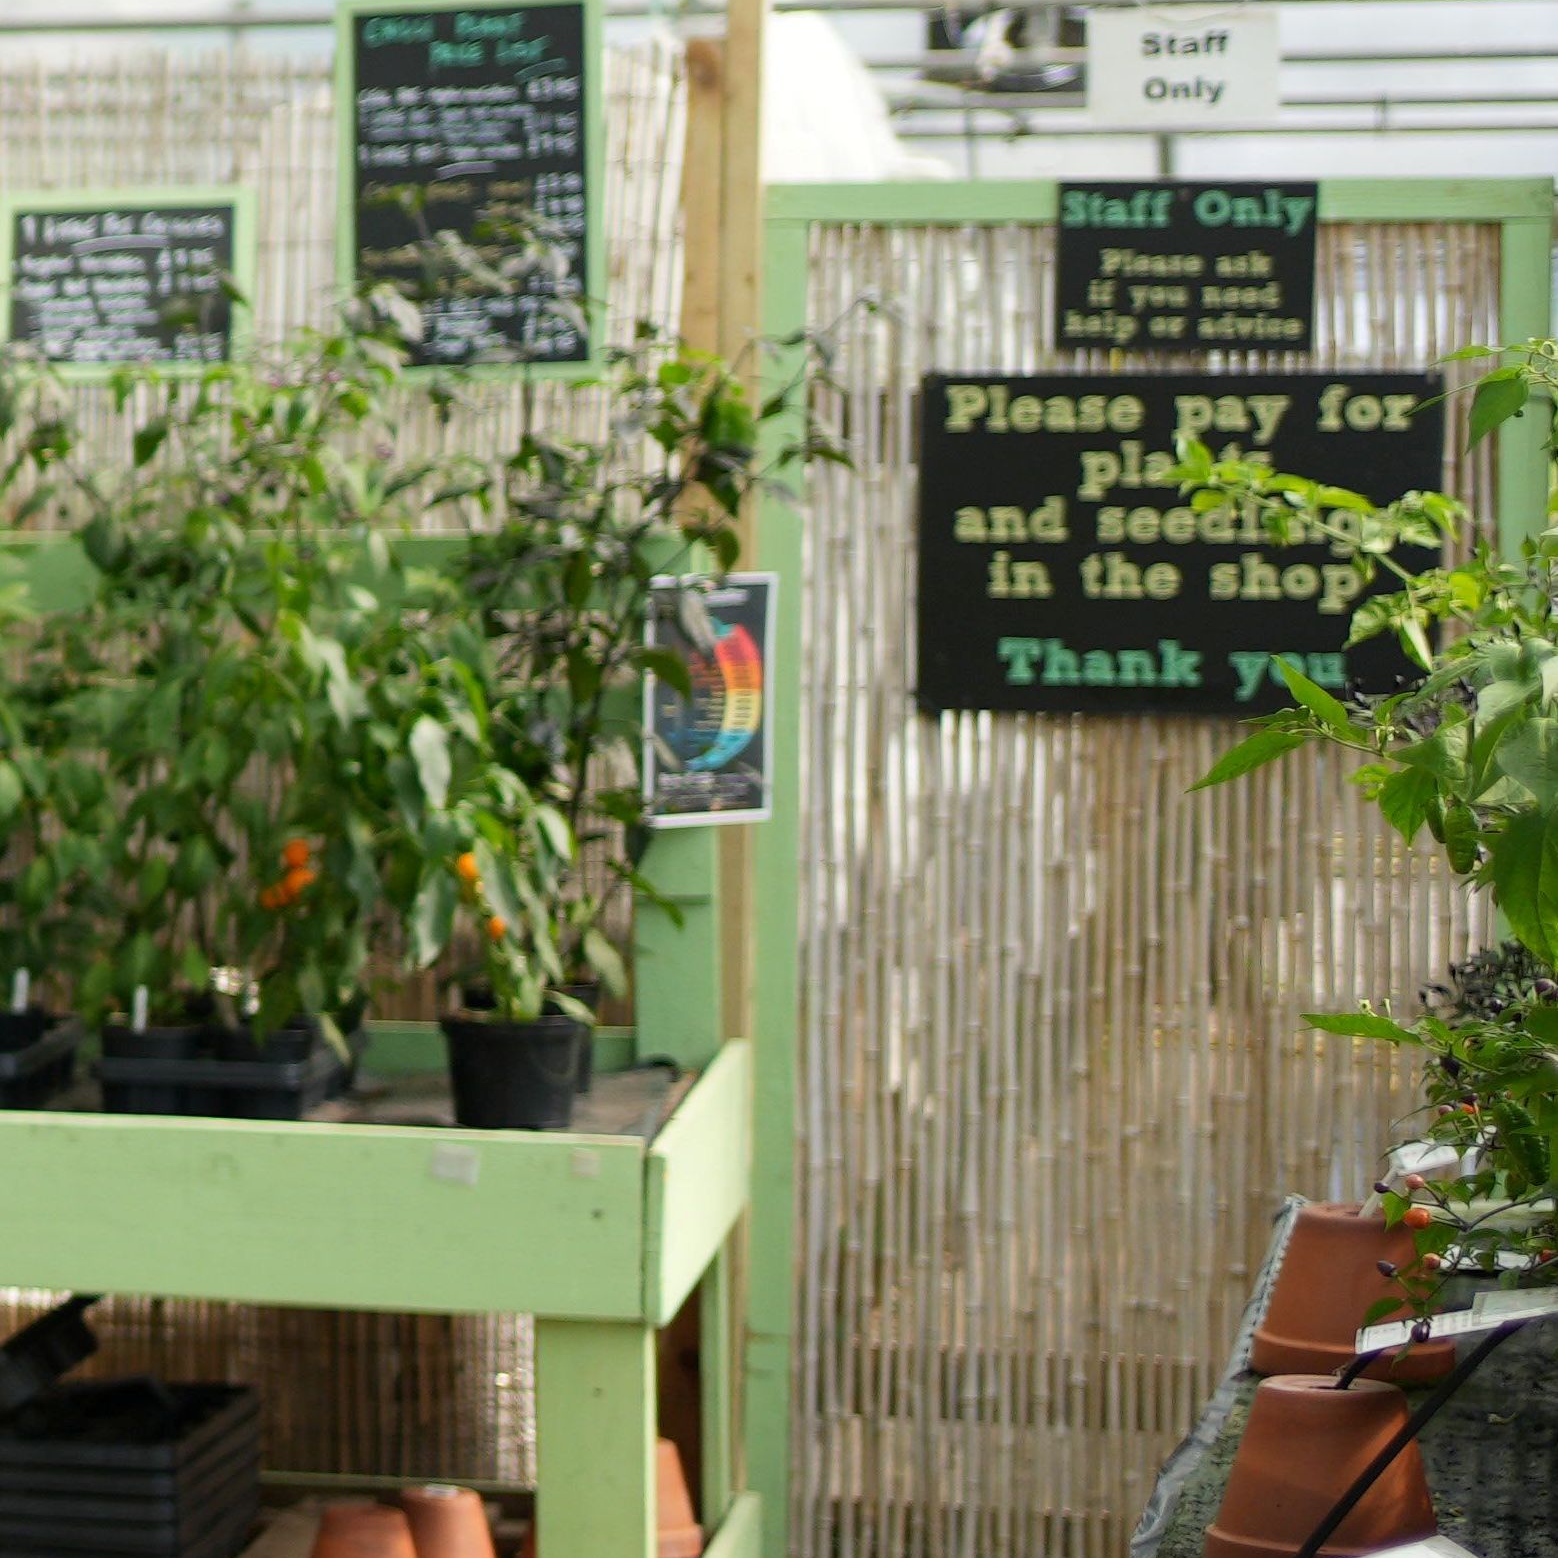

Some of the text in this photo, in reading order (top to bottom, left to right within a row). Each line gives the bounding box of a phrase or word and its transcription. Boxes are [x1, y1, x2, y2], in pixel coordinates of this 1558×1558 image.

[1142, 29, 1231, 58] Staff
[1144, 77, 1225, 105] Only
[1062, 189, 1313, 237] Staff Only
[1099, 247, 1273, 278] Please ask
[1087, 278, 1281, 314] if you need
[1064, 309, 1304, 344] help or advice
[944, 384, 1419, 443] Please pay for
[1077, 440, 1273, 502] pla
[954, 495, 1070, 543] and
[987, 551, 1364, 614] in the shop
[997, 637, 1204, 687] Thank
